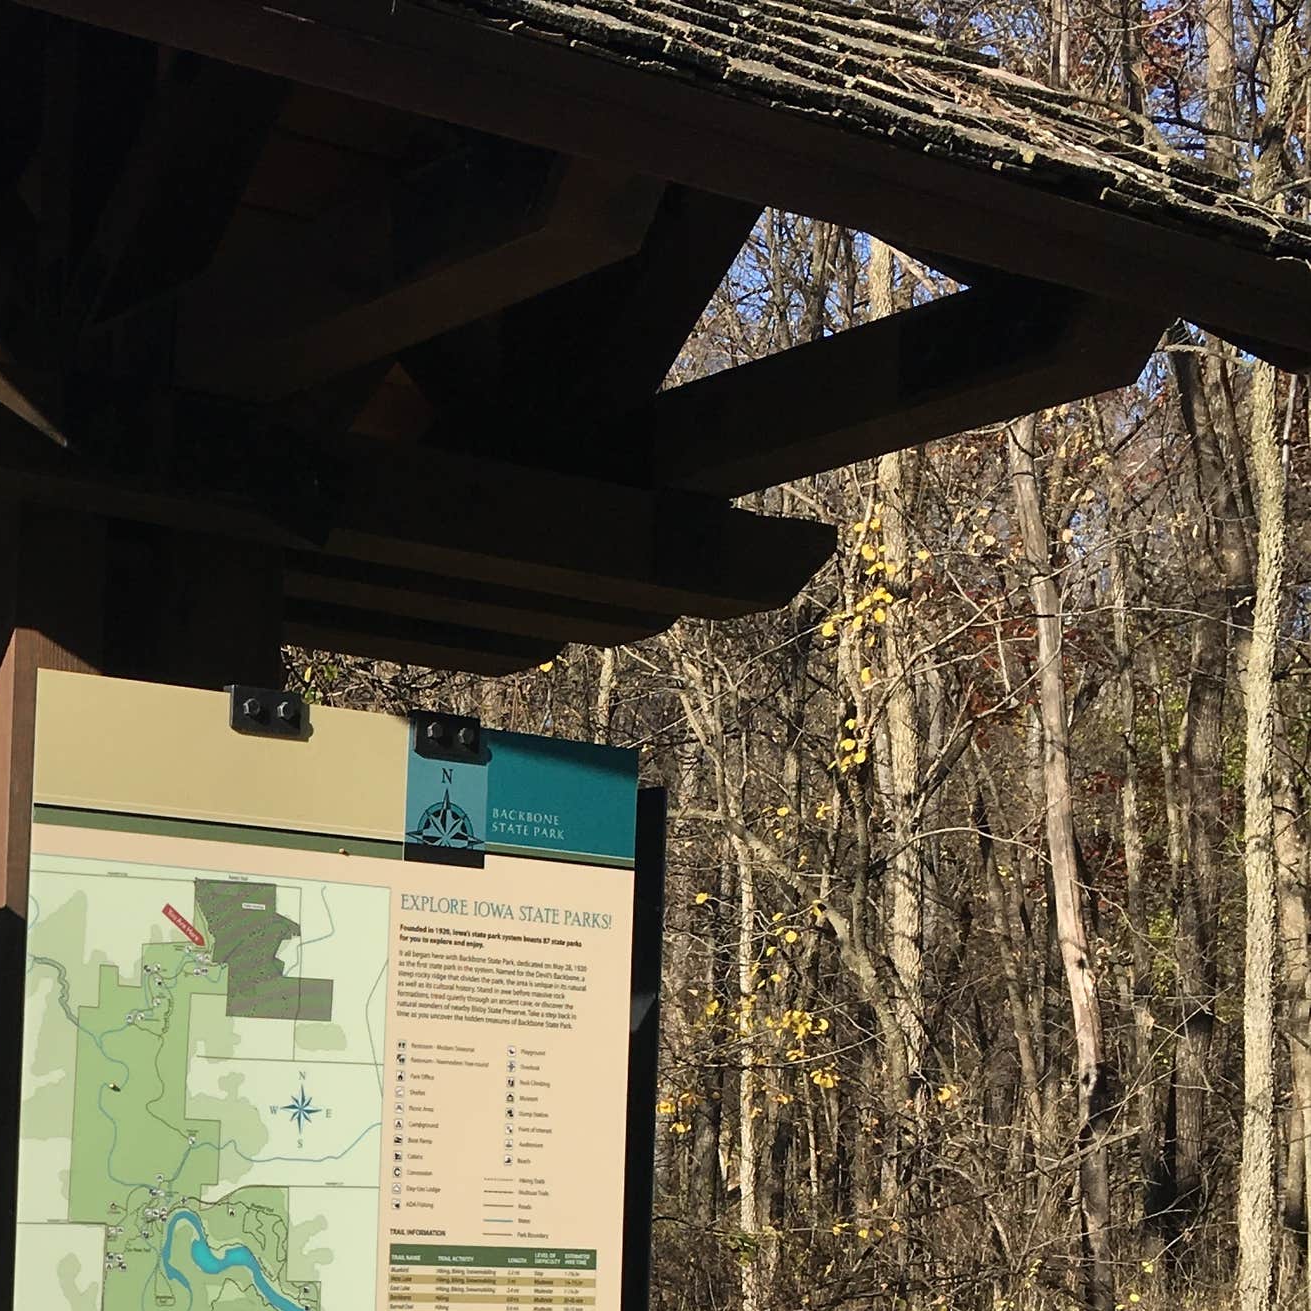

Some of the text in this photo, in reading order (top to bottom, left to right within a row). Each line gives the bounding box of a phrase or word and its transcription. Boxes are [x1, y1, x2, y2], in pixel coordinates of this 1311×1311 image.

[441, 768, 452, 784] N
[492, 807, 559, 825] BACKBONE
[492, 821, 564, 840] STATE PARK
[400, 893, 611, 929] EXPLORE IOWA STATE PARKS!
[298, 1071, 305, 1080] N
[269, 1105, 278, 1114] W
[325, 1108, 331, 1118] E
[297, 1139, 302, 1148] S
